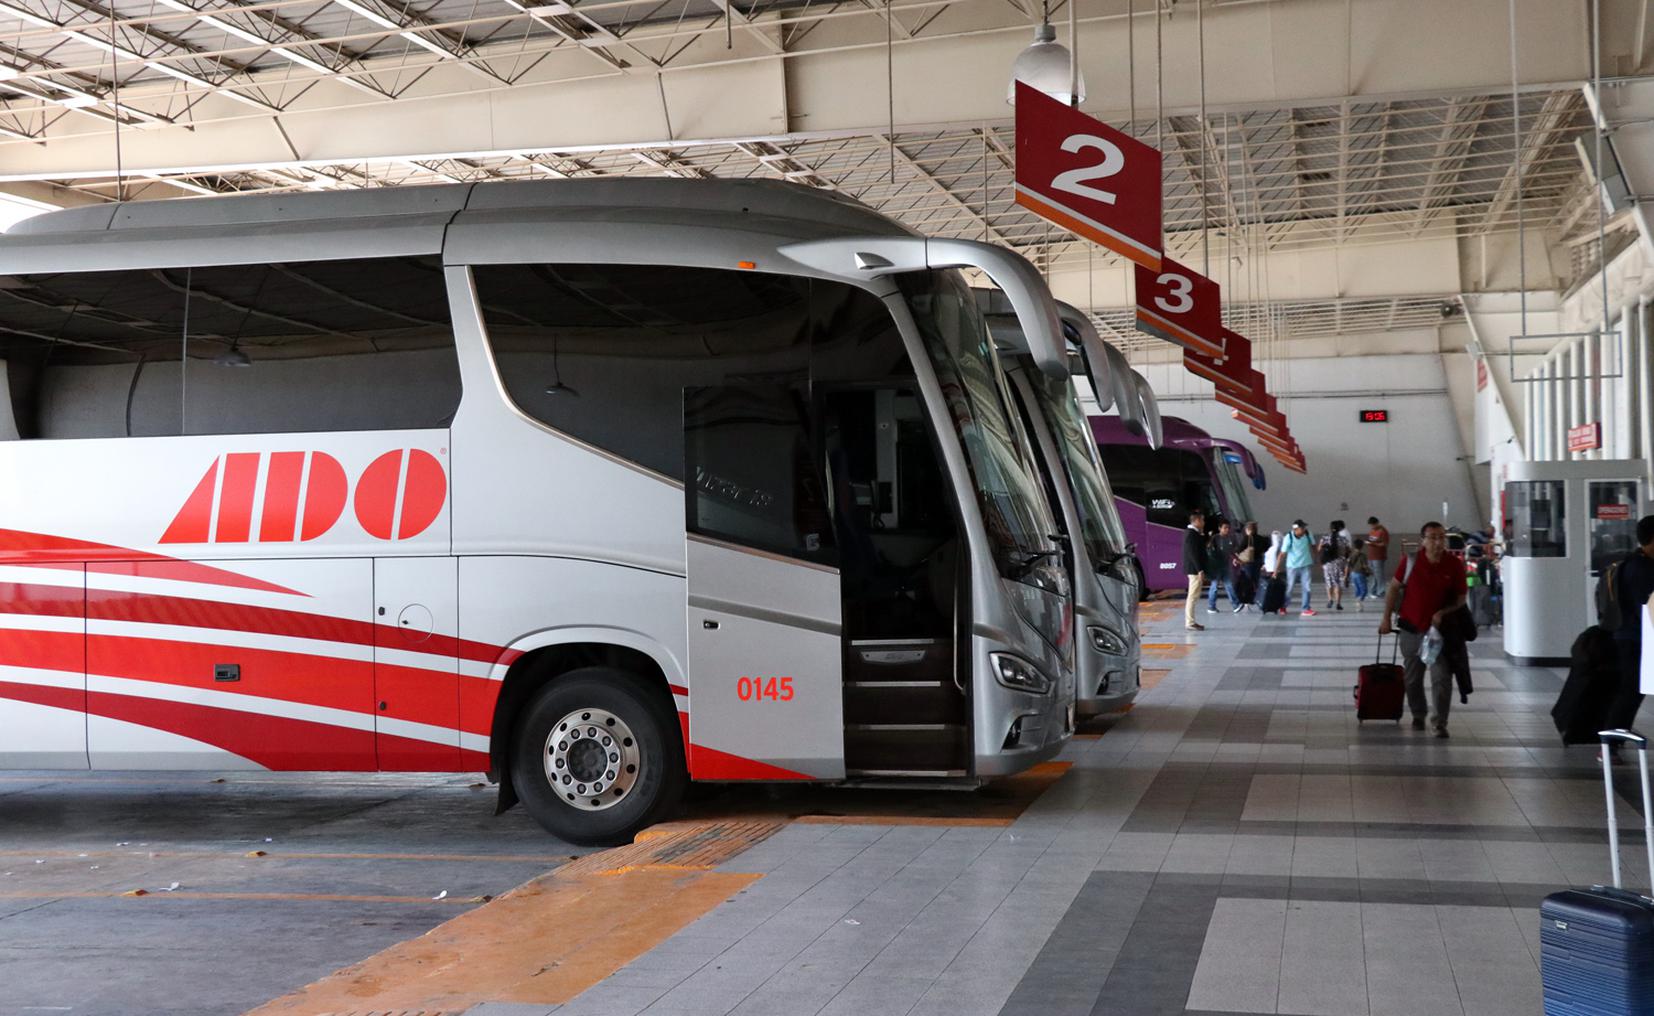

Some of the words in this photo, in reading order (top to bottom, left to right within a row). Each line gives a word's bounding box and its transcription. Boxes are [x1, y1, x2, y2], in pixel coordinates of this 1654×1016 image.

[1050, 134, 1125, 205] 2
[1154, 273, 1194, 313] 3
[157, 448, 447, 544] ADO
[737, 677, 794, 702] 0145
